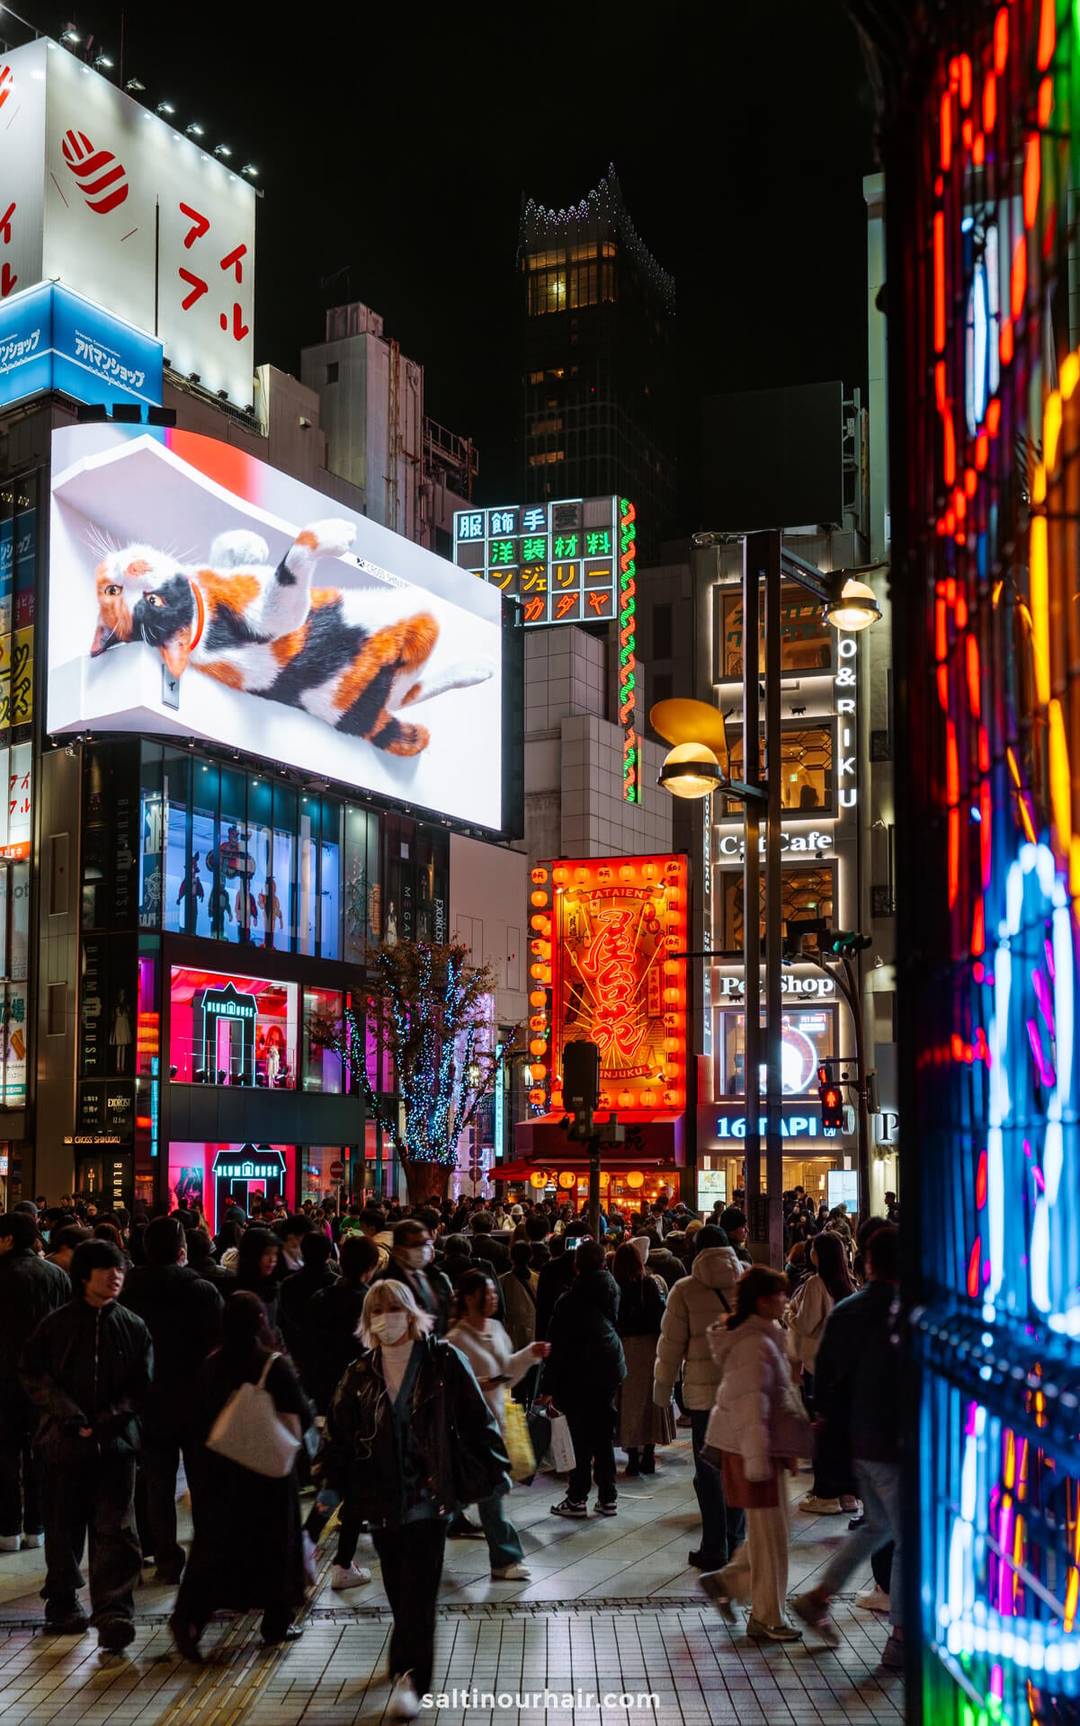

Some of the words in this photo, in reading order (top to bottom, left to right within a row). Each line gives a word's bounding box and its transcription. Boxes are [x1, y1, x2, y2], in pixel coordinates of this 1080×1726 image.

[74, 337, 145, 388] アパマンショップ
[491, 531, 611, 564] 洋装材料
[471, 564, 610, 592] ンジェリー
[586, 888, 644, 900] YATAIEN
[207, 1001, 254, 1018] BLUMHOUSE
[599, 1067, 643, 1079] INJUKU
[217, 1161, 278, 1177] BLUMHOUSE
